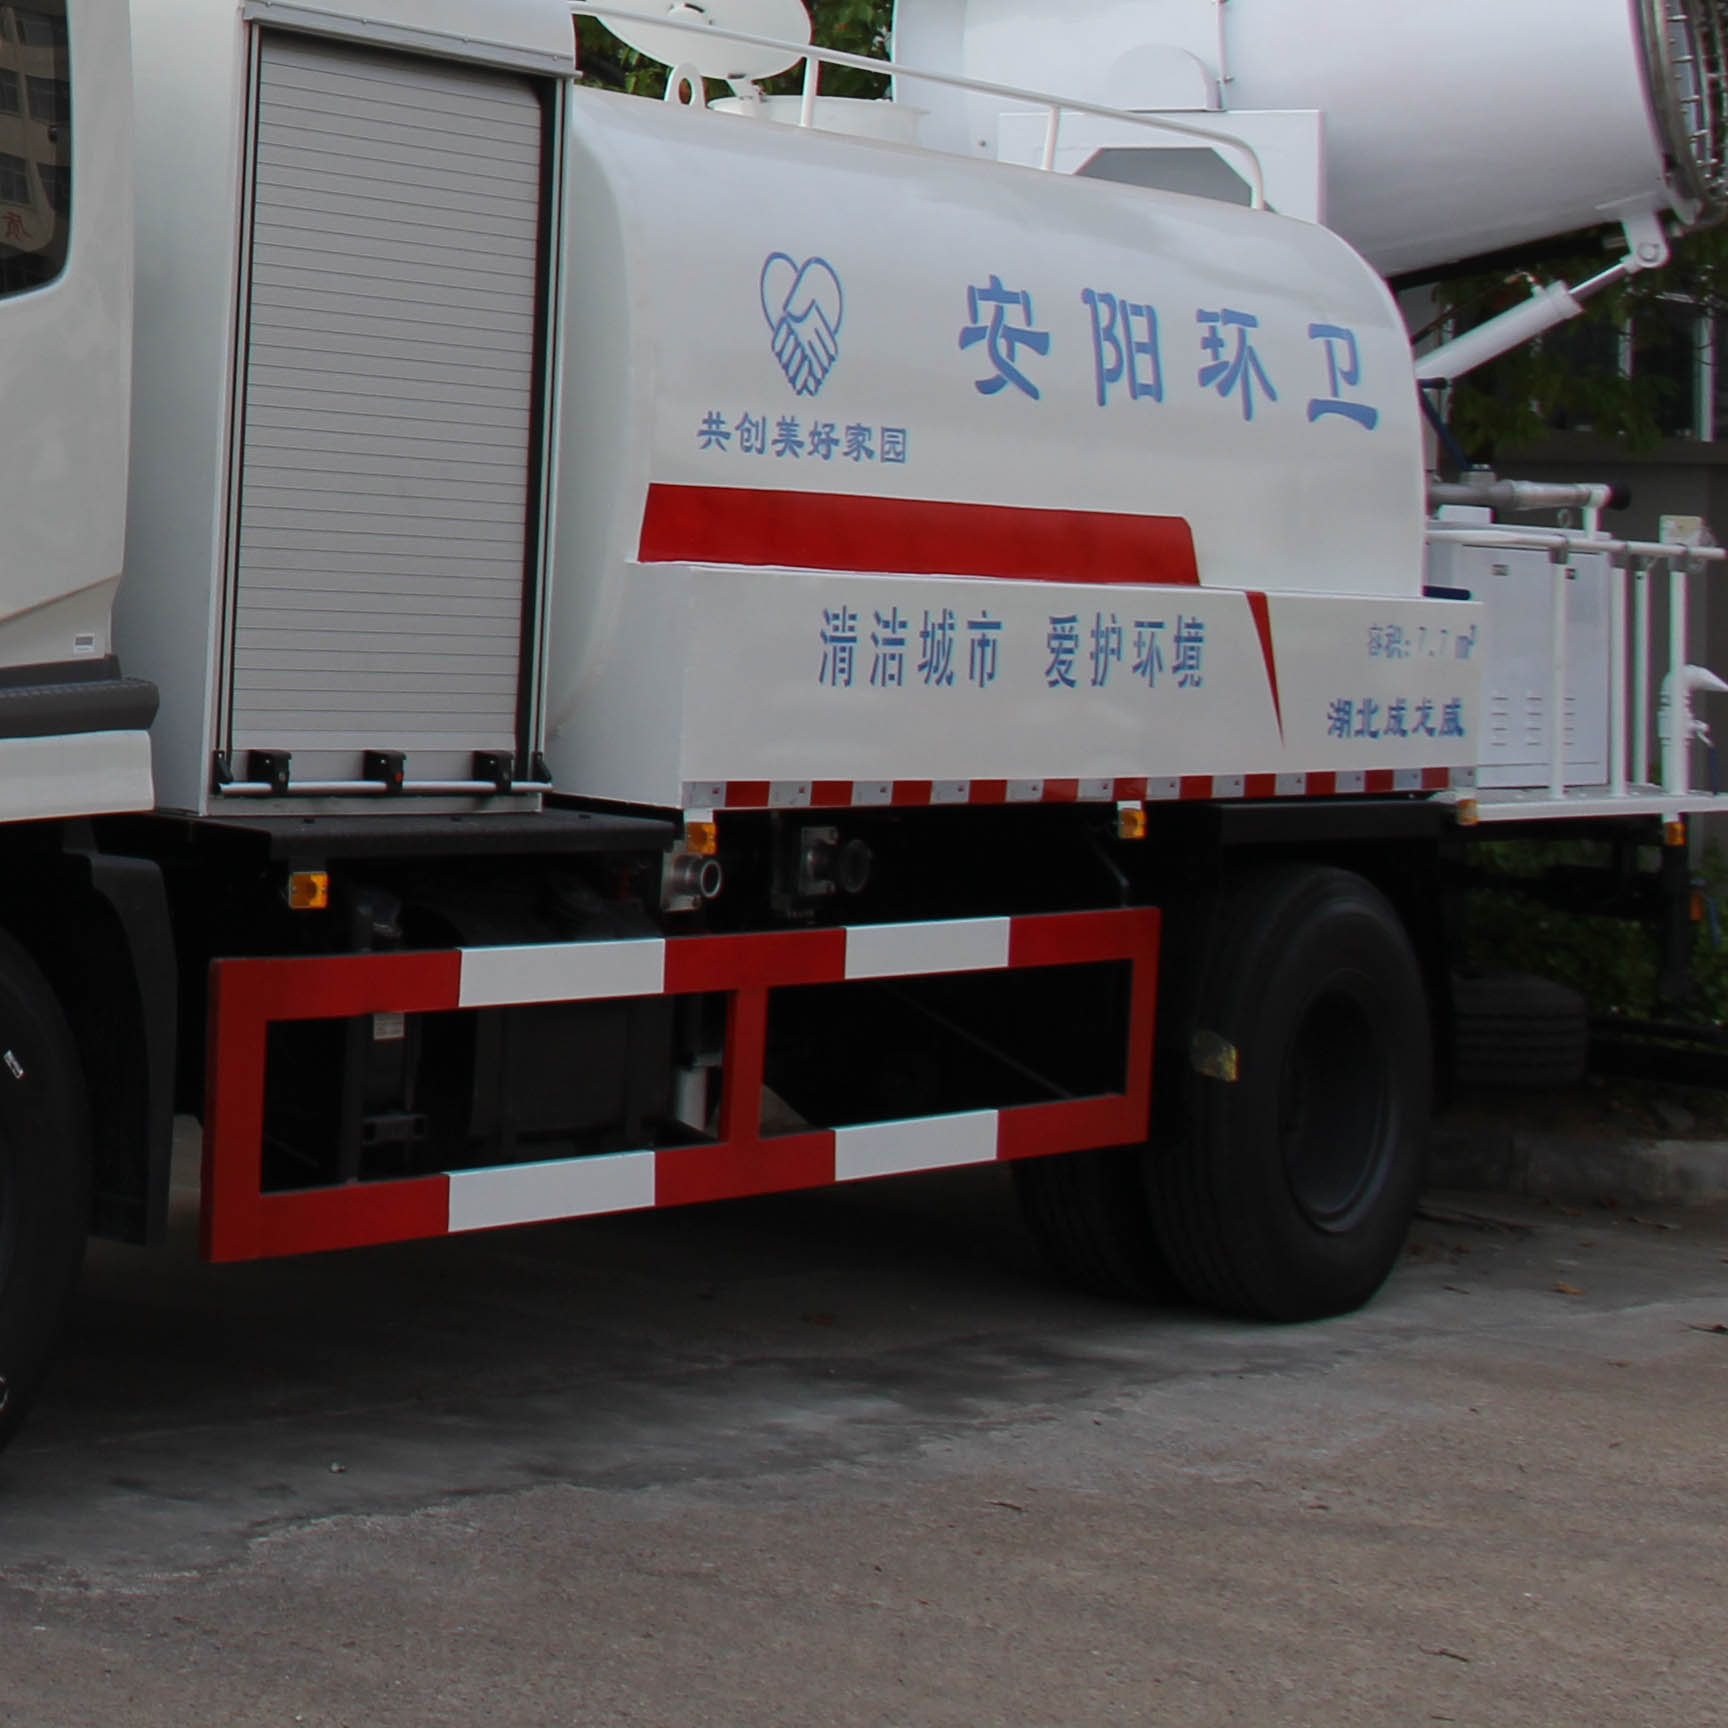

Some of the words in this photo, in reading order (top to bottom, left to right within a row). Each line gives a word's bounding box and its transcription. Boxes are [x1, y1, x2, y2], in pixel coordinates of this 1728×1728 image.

[958, 274, 1379, 430] 安阳环卫
[696, 410, 907, 465] 共创美好家园
[818, 605, 1003, 689] 清洁城市
[1044, 613, 1206, 689] 爱护环境
